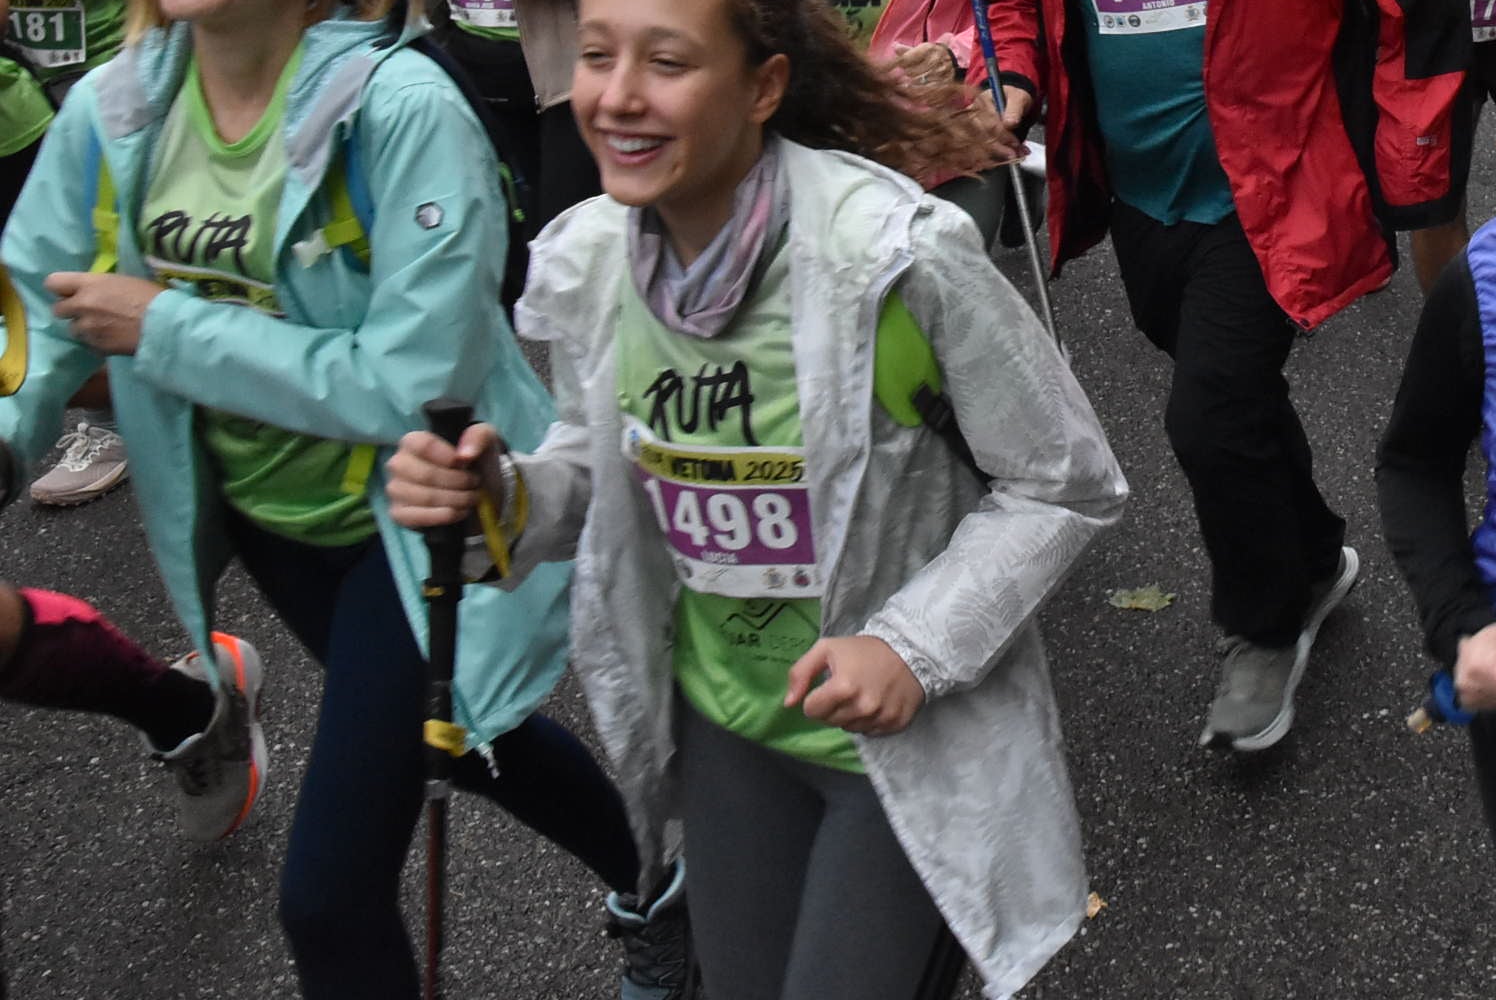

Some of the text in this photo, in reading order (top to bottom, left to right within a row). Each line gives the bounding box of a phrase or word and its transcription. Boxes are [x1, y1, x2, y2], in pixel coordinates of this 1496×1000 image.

[1142, 0, 1176, 11] ANTONIO
[146, 209, 252, 279] RUTA
[642, 359, 761, 447] RUTA
[743, 459, 808, 483] 2025
[643, 478, 798, 551] 1498
